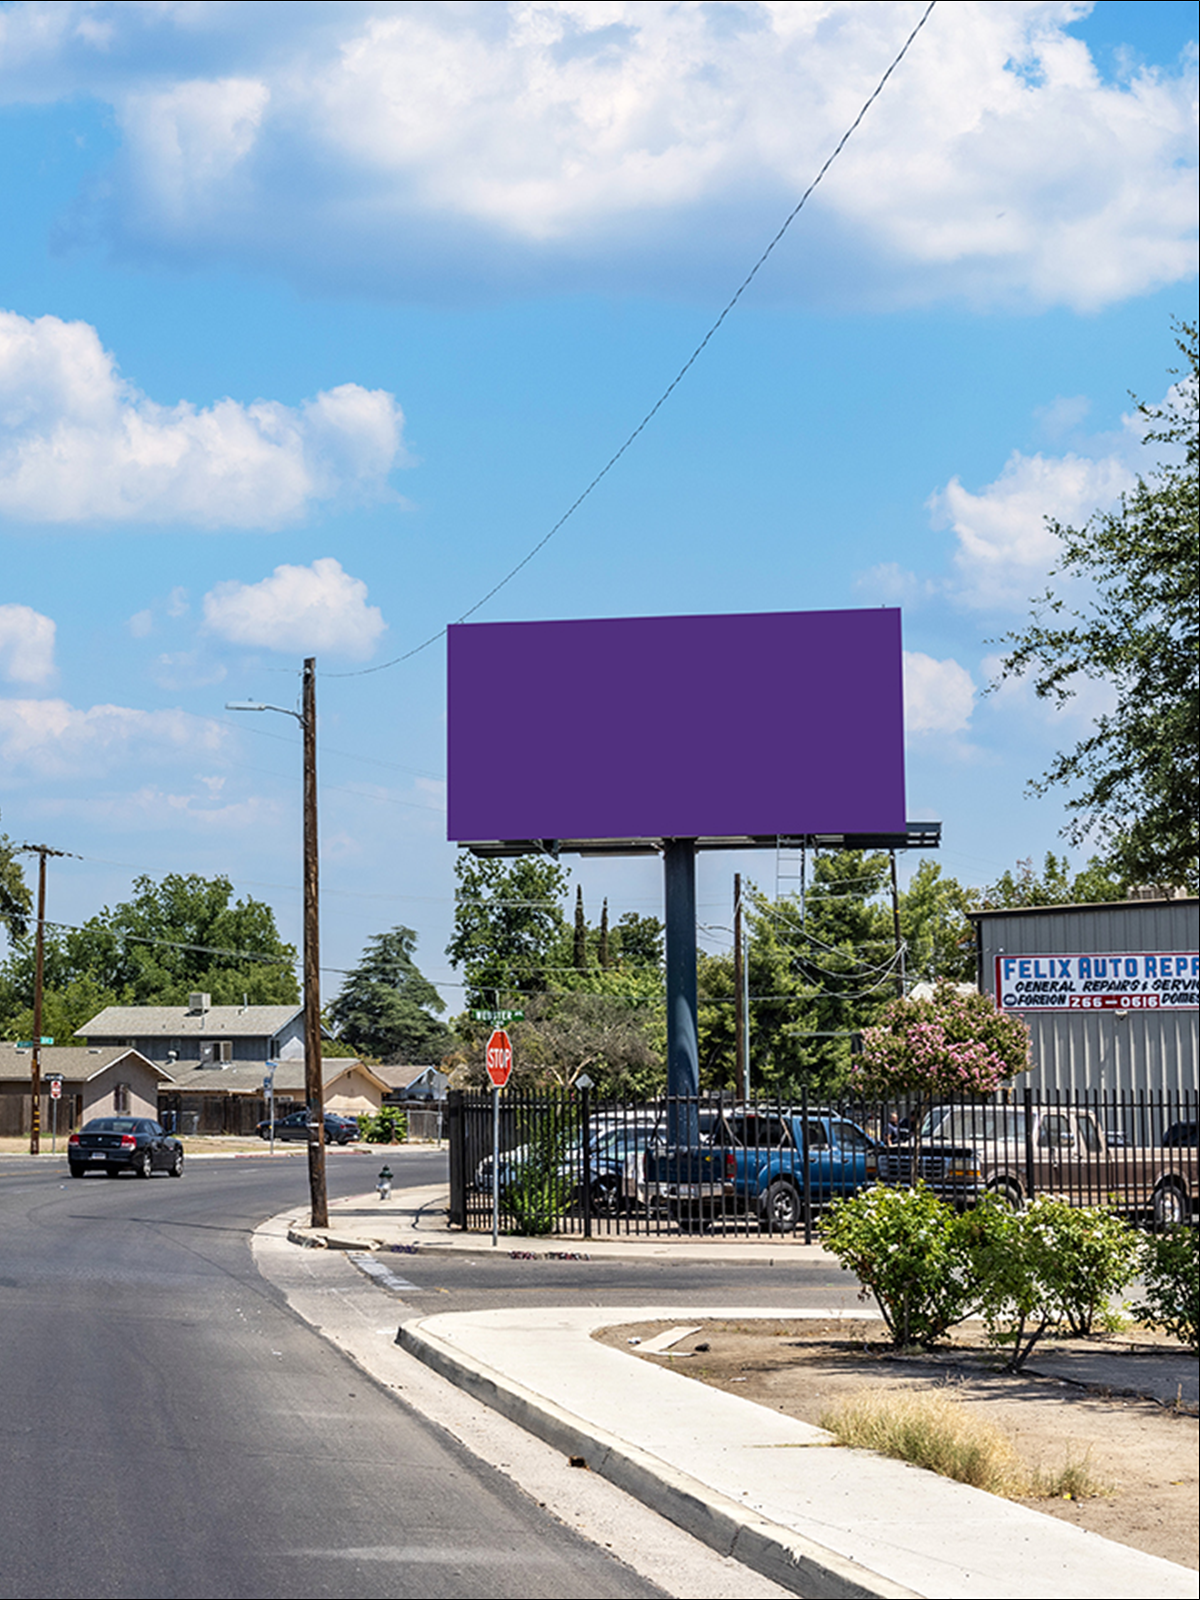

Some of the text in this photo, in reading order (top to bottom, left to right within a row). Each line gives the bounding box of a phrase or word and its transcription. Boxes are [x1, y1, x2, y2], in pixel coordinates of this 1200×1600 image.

[1004, 959, 1071, 980] FELIX
[1078, 957, 1138, 979] AUTO
[1015, 981, 1076, 993] GENERAL
[1082, 980, 1138, 992] REPAIRS
[488, 1048, 511, 1068] STOP
